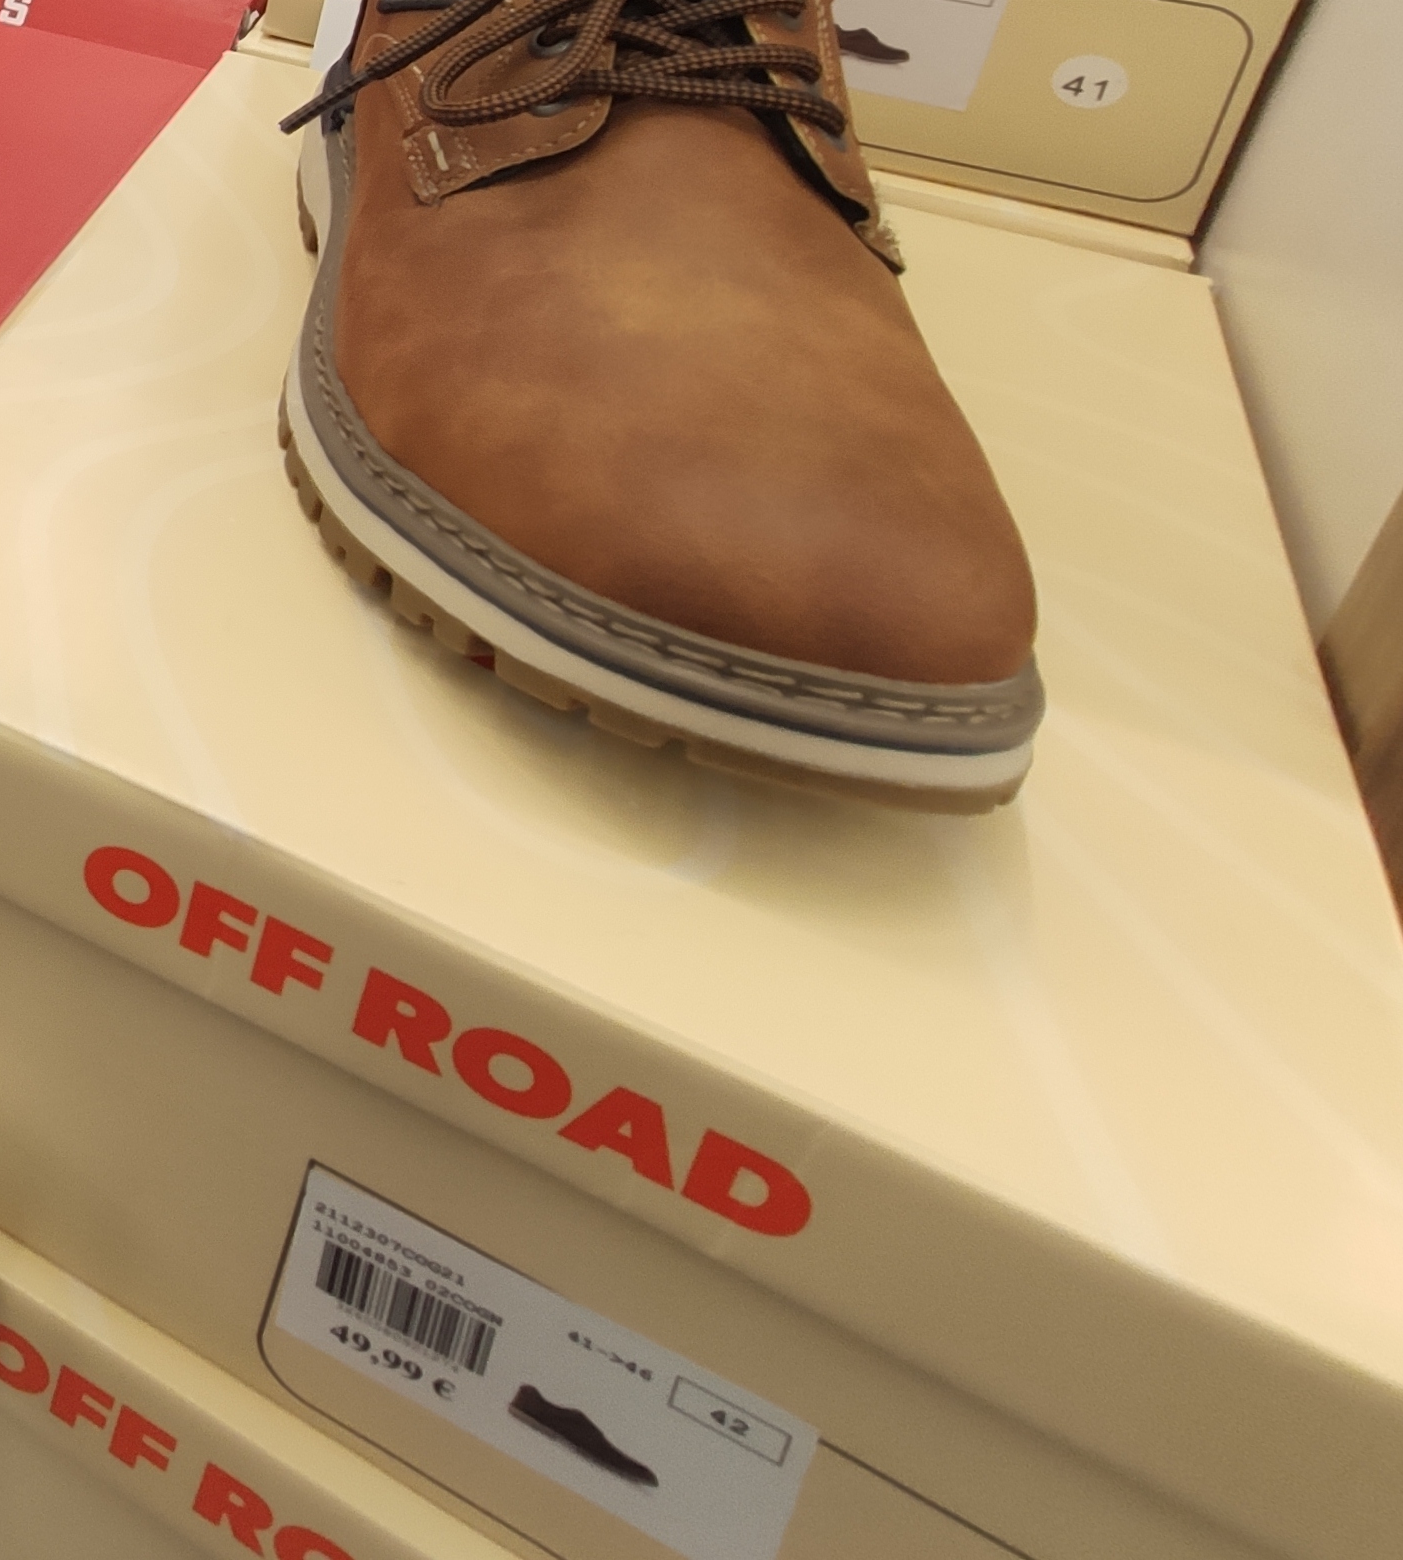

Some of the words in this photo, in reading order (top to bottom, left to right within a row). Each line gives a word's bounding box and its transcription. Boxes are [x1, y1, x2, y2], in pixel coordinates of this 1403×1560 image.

[1060, 74, 1111, 101] 41
[84, 845, 334, 997] OFF
[351, 967, 813, 1239] ROAD
[330, 1324, 424, 1383] 49,99
[433, 1377, 458, 1402] €
[709, 1409, 751, 1437] 42
